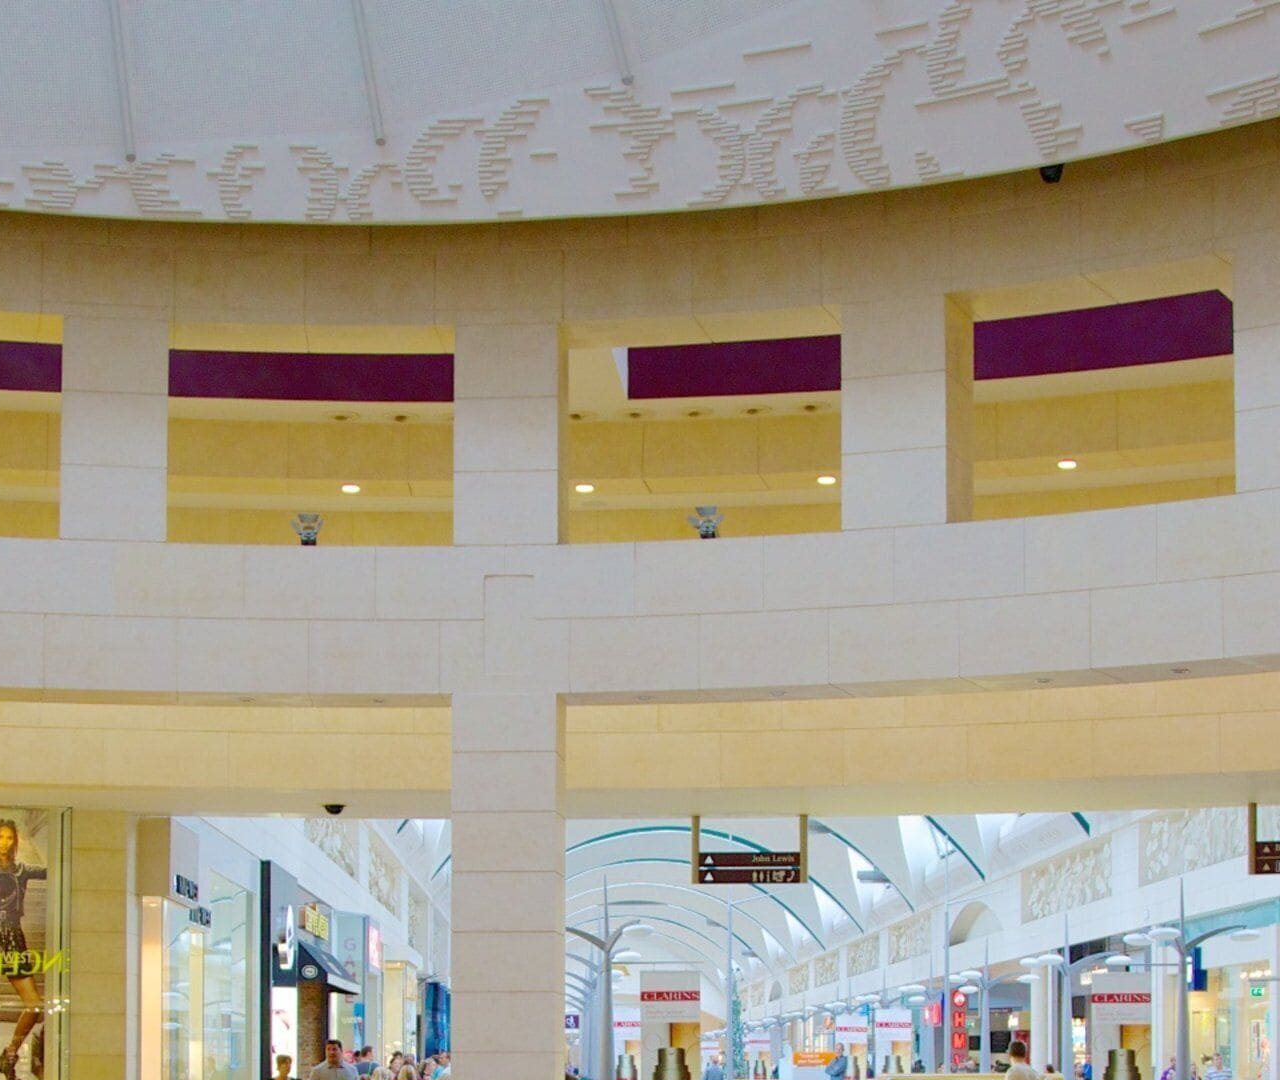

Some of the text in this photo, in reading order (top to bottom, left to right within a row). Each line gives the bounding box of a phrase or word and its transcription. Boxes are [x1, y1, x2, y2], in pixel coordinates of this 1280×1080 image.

[752, 854, 795, 863] John Lewis
[644, 990, 700, 1001] CLARINS
[1093, 993, 1151, 1003] CLARINS
